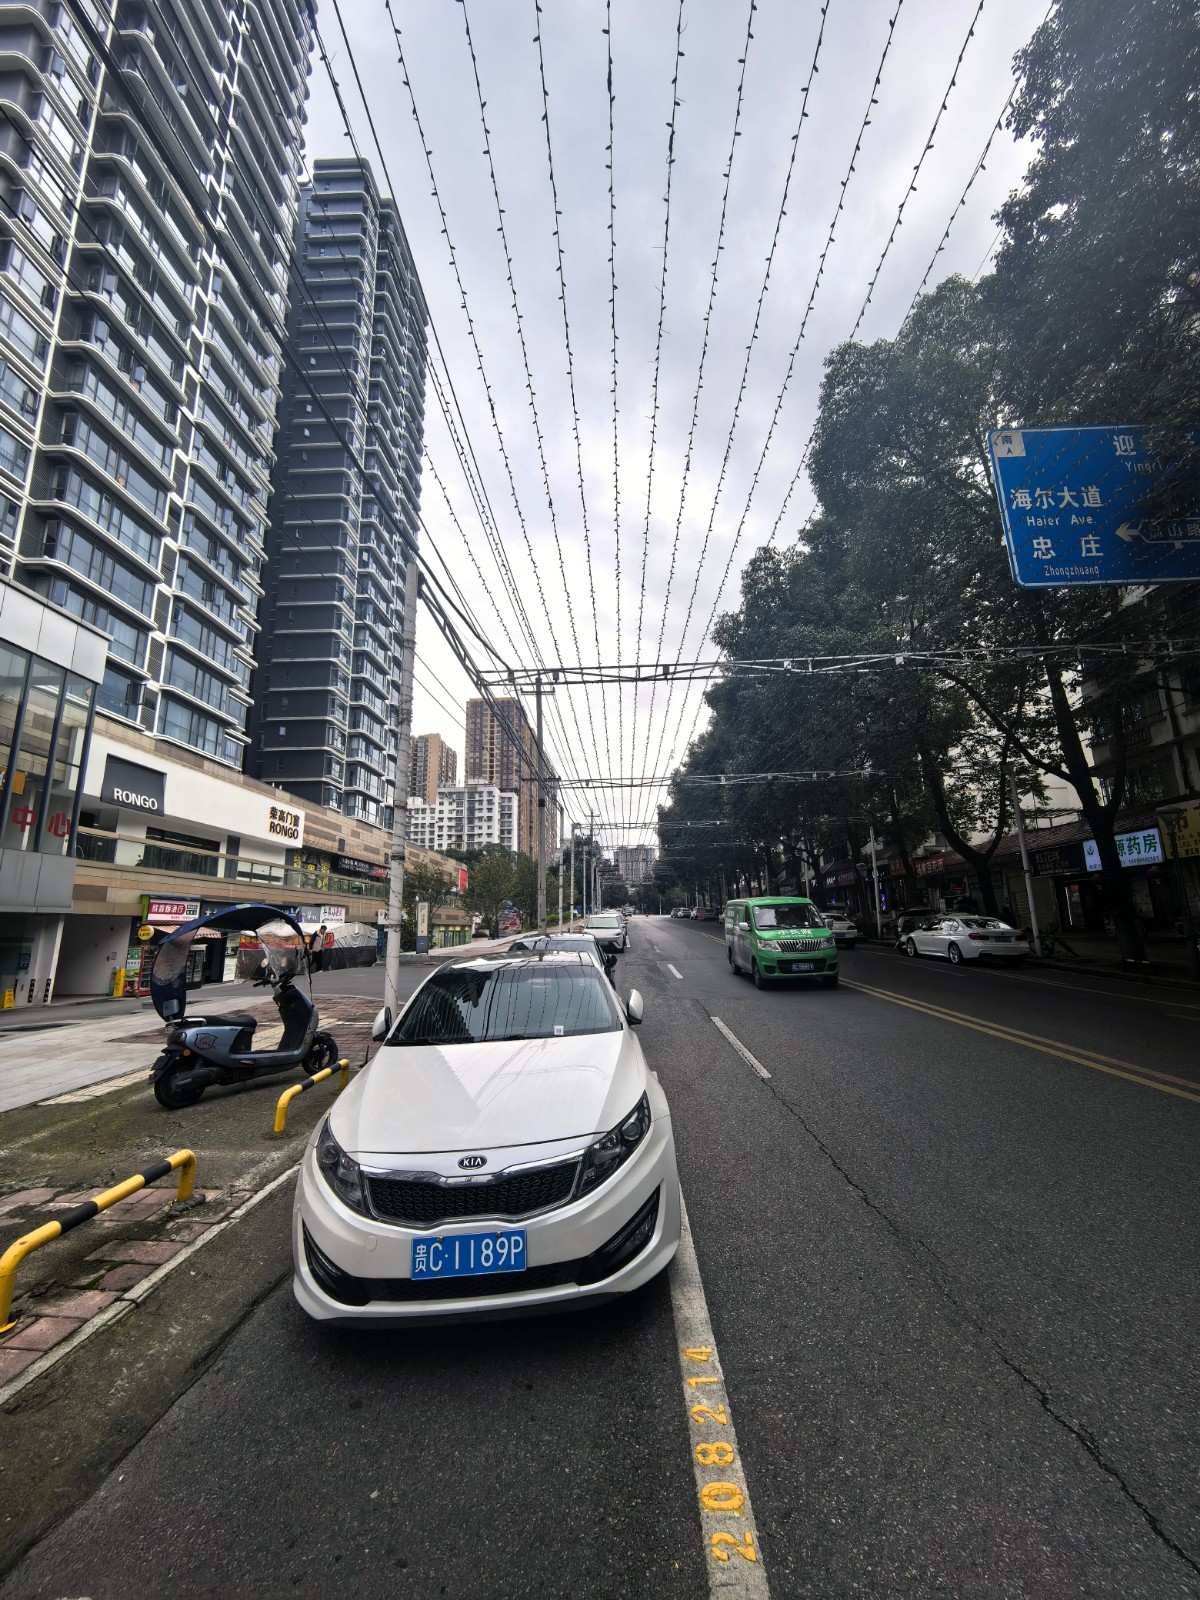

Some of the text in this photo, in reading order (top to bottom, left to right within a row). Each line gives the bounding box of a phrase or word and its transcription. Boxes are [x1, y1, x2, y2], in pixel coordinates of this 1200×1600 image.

[1001, 434, 1012, 444] 南
[1010, 485, 1104, 511] 海尔大道
[1026, 515, 1060, 527] Haier
[112, 787, 158, 810] RONGO
[269, 821, 299, 840] RONGO
[462, 1157, 483, 1167] KIA
[682, 1346, 758, 1563] 208214
